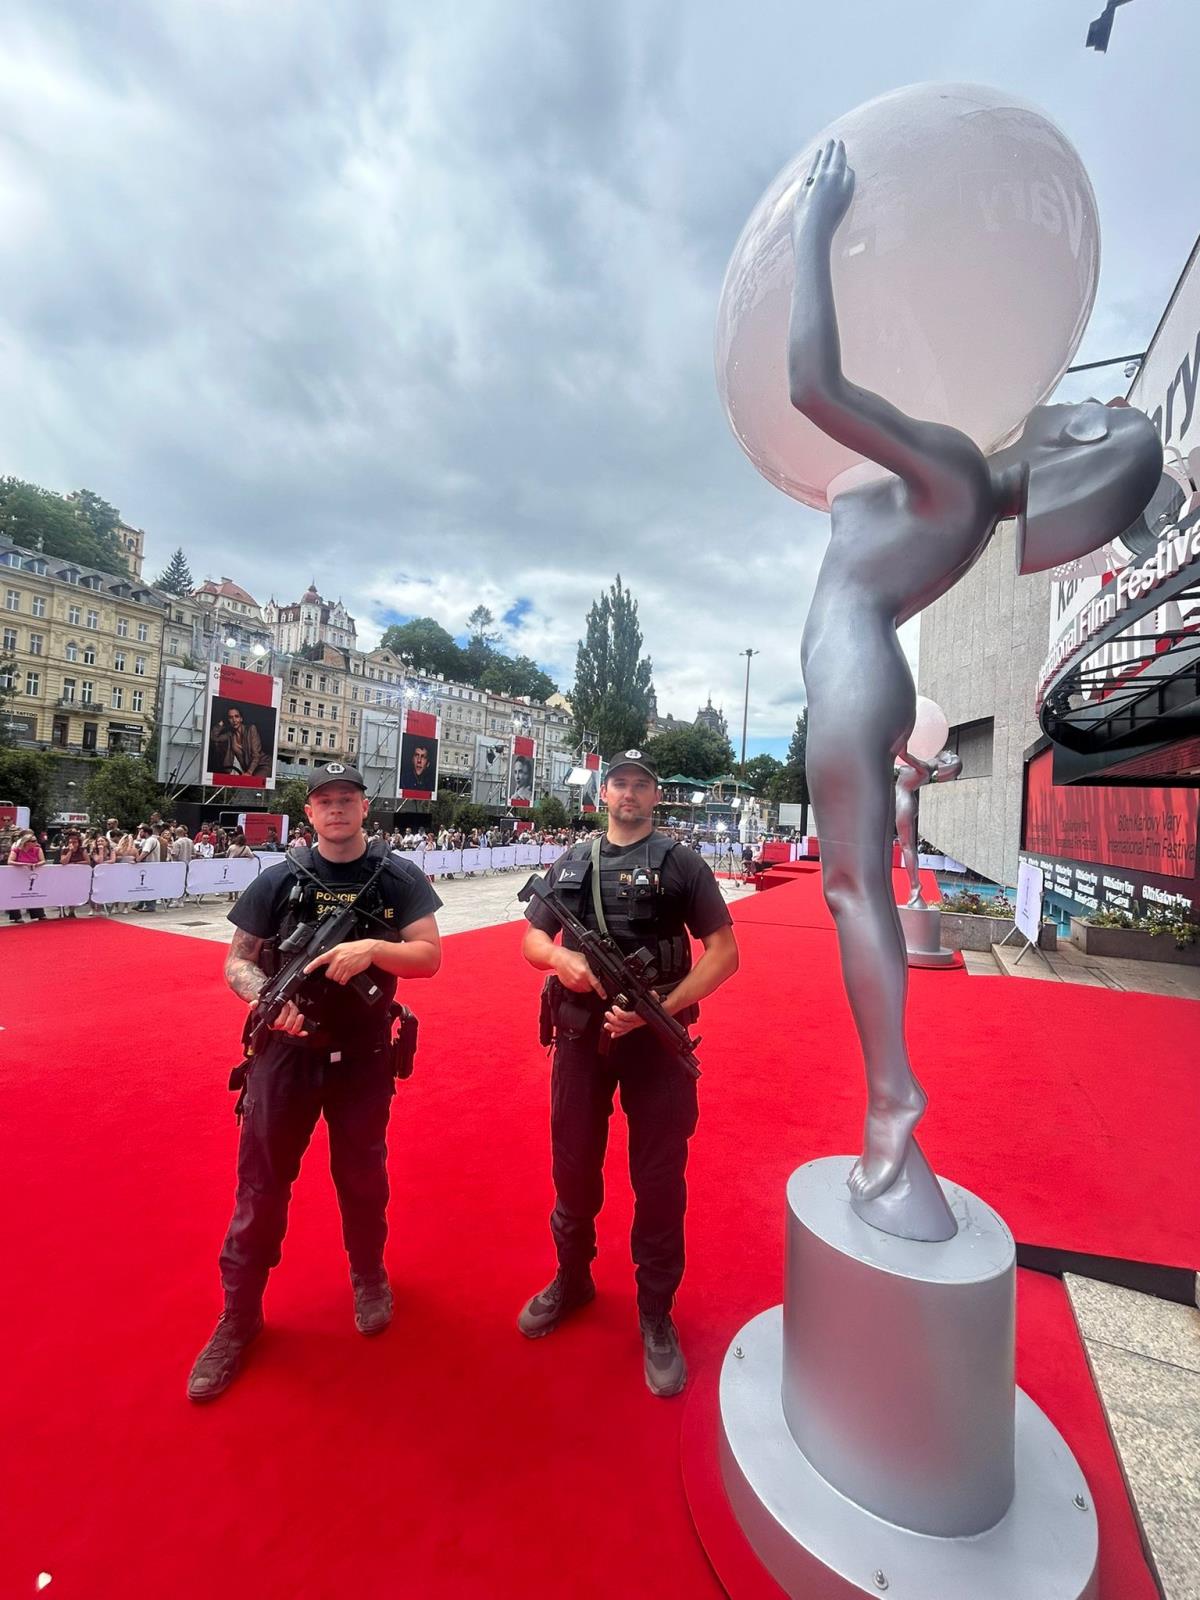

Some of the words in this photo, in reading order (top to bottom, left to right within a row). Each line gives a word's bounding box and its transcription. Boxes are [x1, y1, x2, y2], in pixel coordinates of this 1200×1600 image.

[1146, 331, 1200, 446] ary
[1080, 594, 1116, 641] Film
[1162, 811, 1182, 835] Vary
[1145, 837, 1161, 856] Film
